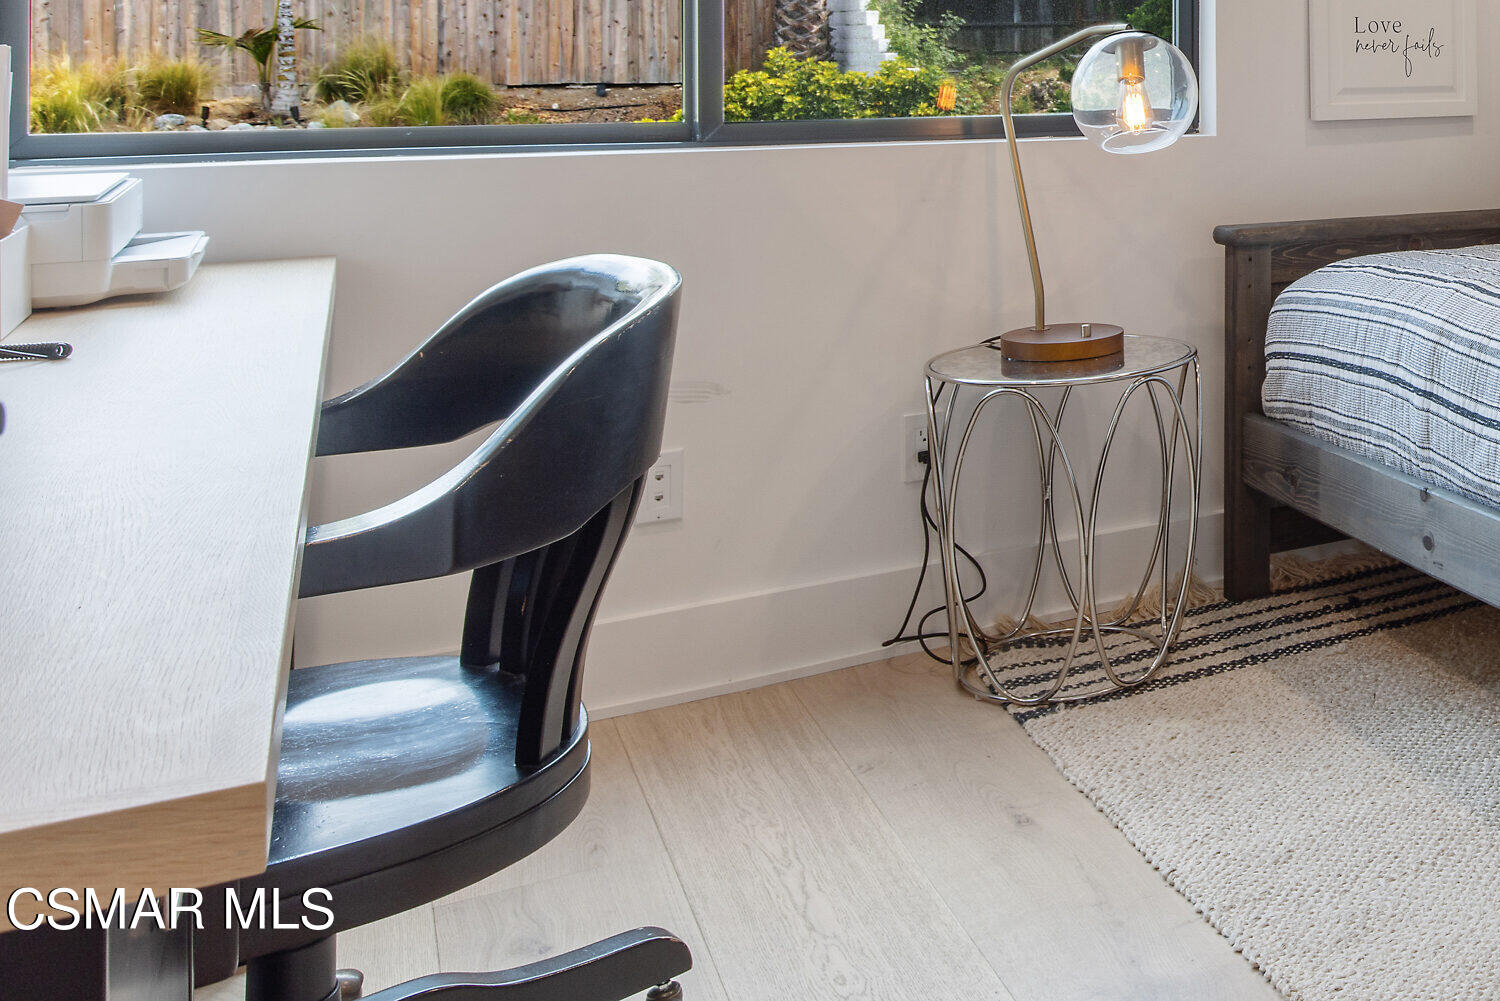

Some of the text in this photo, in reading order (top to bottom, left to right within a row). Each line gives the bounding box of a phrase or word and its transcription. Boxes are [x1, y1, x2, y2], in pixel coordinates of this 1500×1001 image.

[1354, 16, 1403, 35] Love
[1355, 28, 1445, 78] never fails
